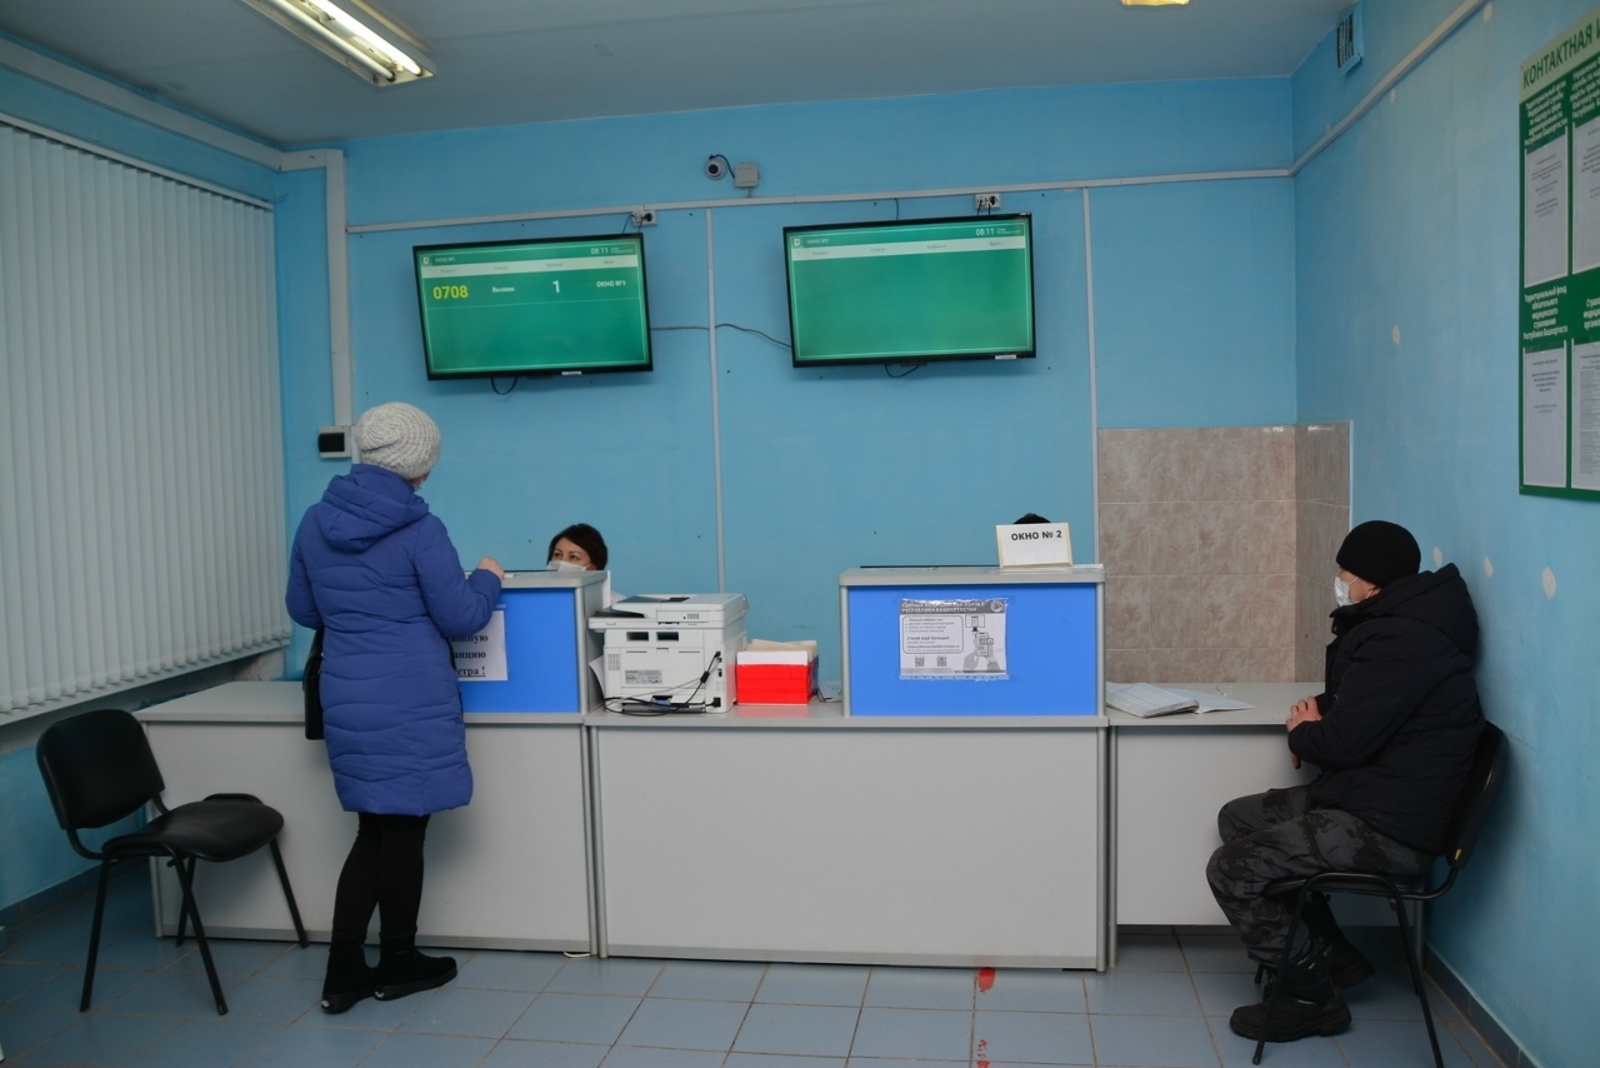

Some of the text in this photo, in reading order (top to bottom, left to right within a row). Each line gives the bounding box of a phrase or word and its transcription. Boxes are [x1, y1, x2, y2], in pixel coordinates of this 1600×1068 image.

[1523, 22, 1592, 89] КОНТАКТНАЯ
[552, 280, 560, 293] 1
[596, 280, 614, 288] ОКНО
[433, 285, 469, 300] 0708
[1011, 530, 1062, 541] ОКНО № 2
[454, 652, 486, 660] анцию
[457, 668, 479, 677] етра
